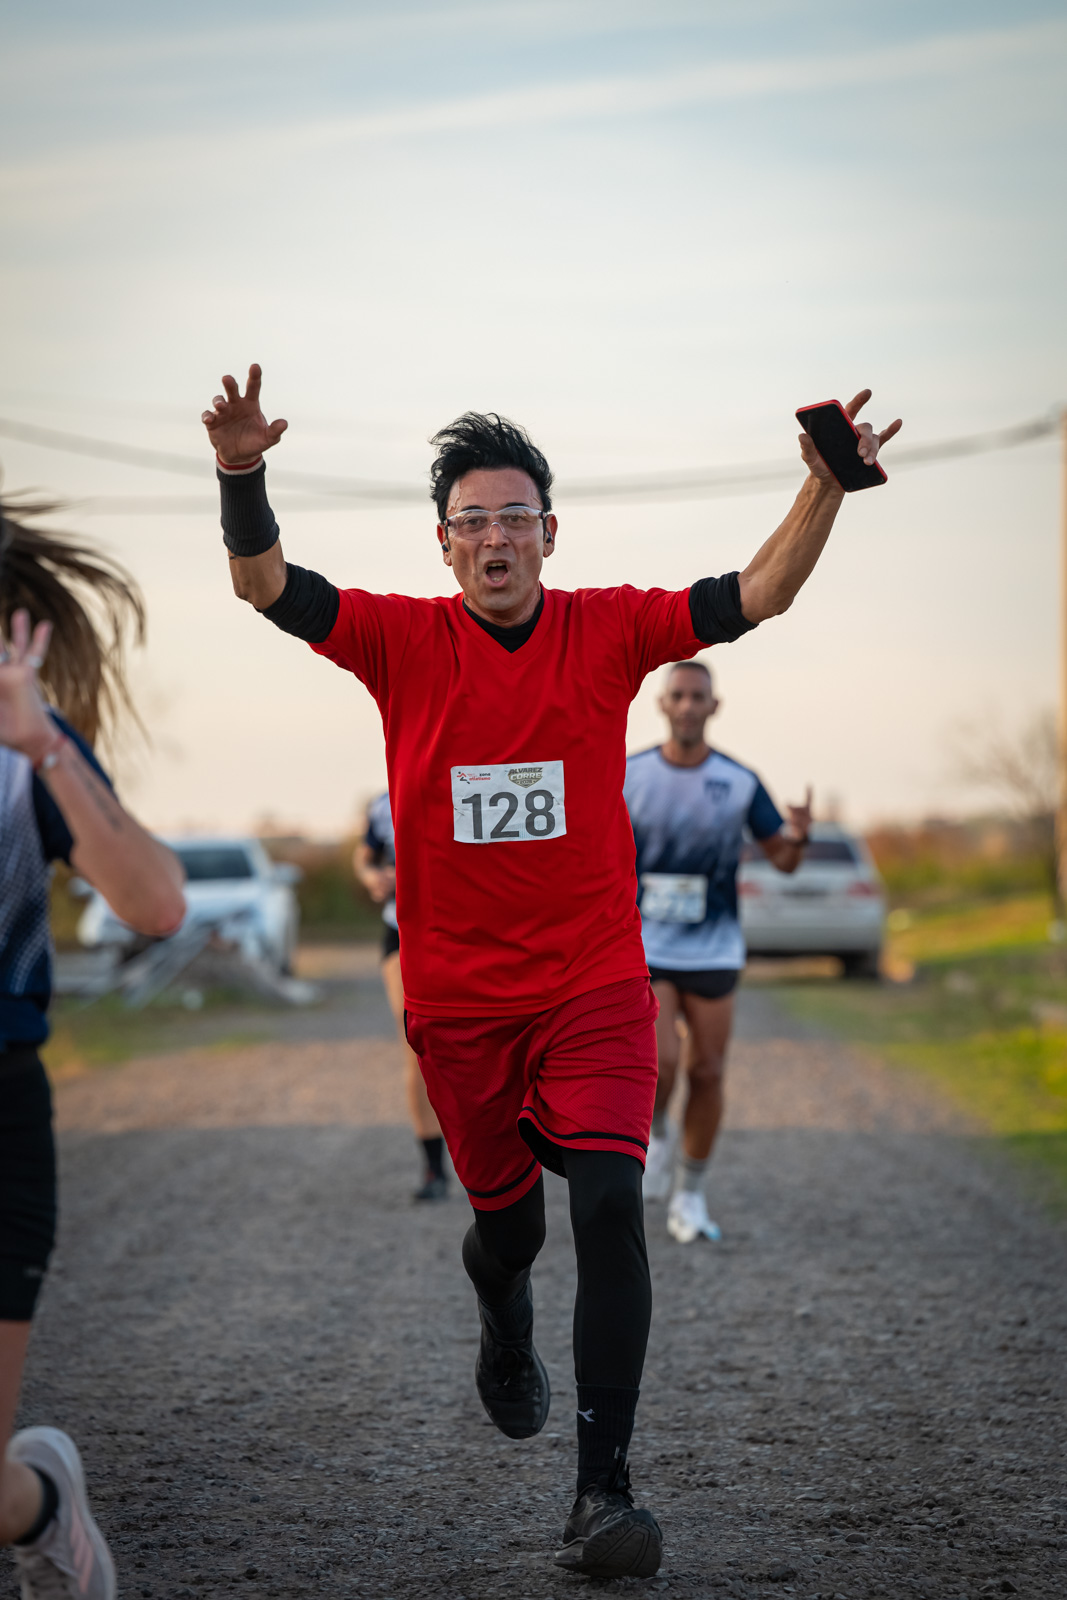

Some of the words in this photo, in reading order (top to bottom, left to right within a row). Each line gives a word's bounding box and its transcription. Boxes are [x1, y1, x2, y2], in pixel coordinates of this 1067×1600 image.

[508, 767, 544, 775] ALVAREZ
[510, 772, 543, 781] CORRE
[462, 789, 556, 840] 128
